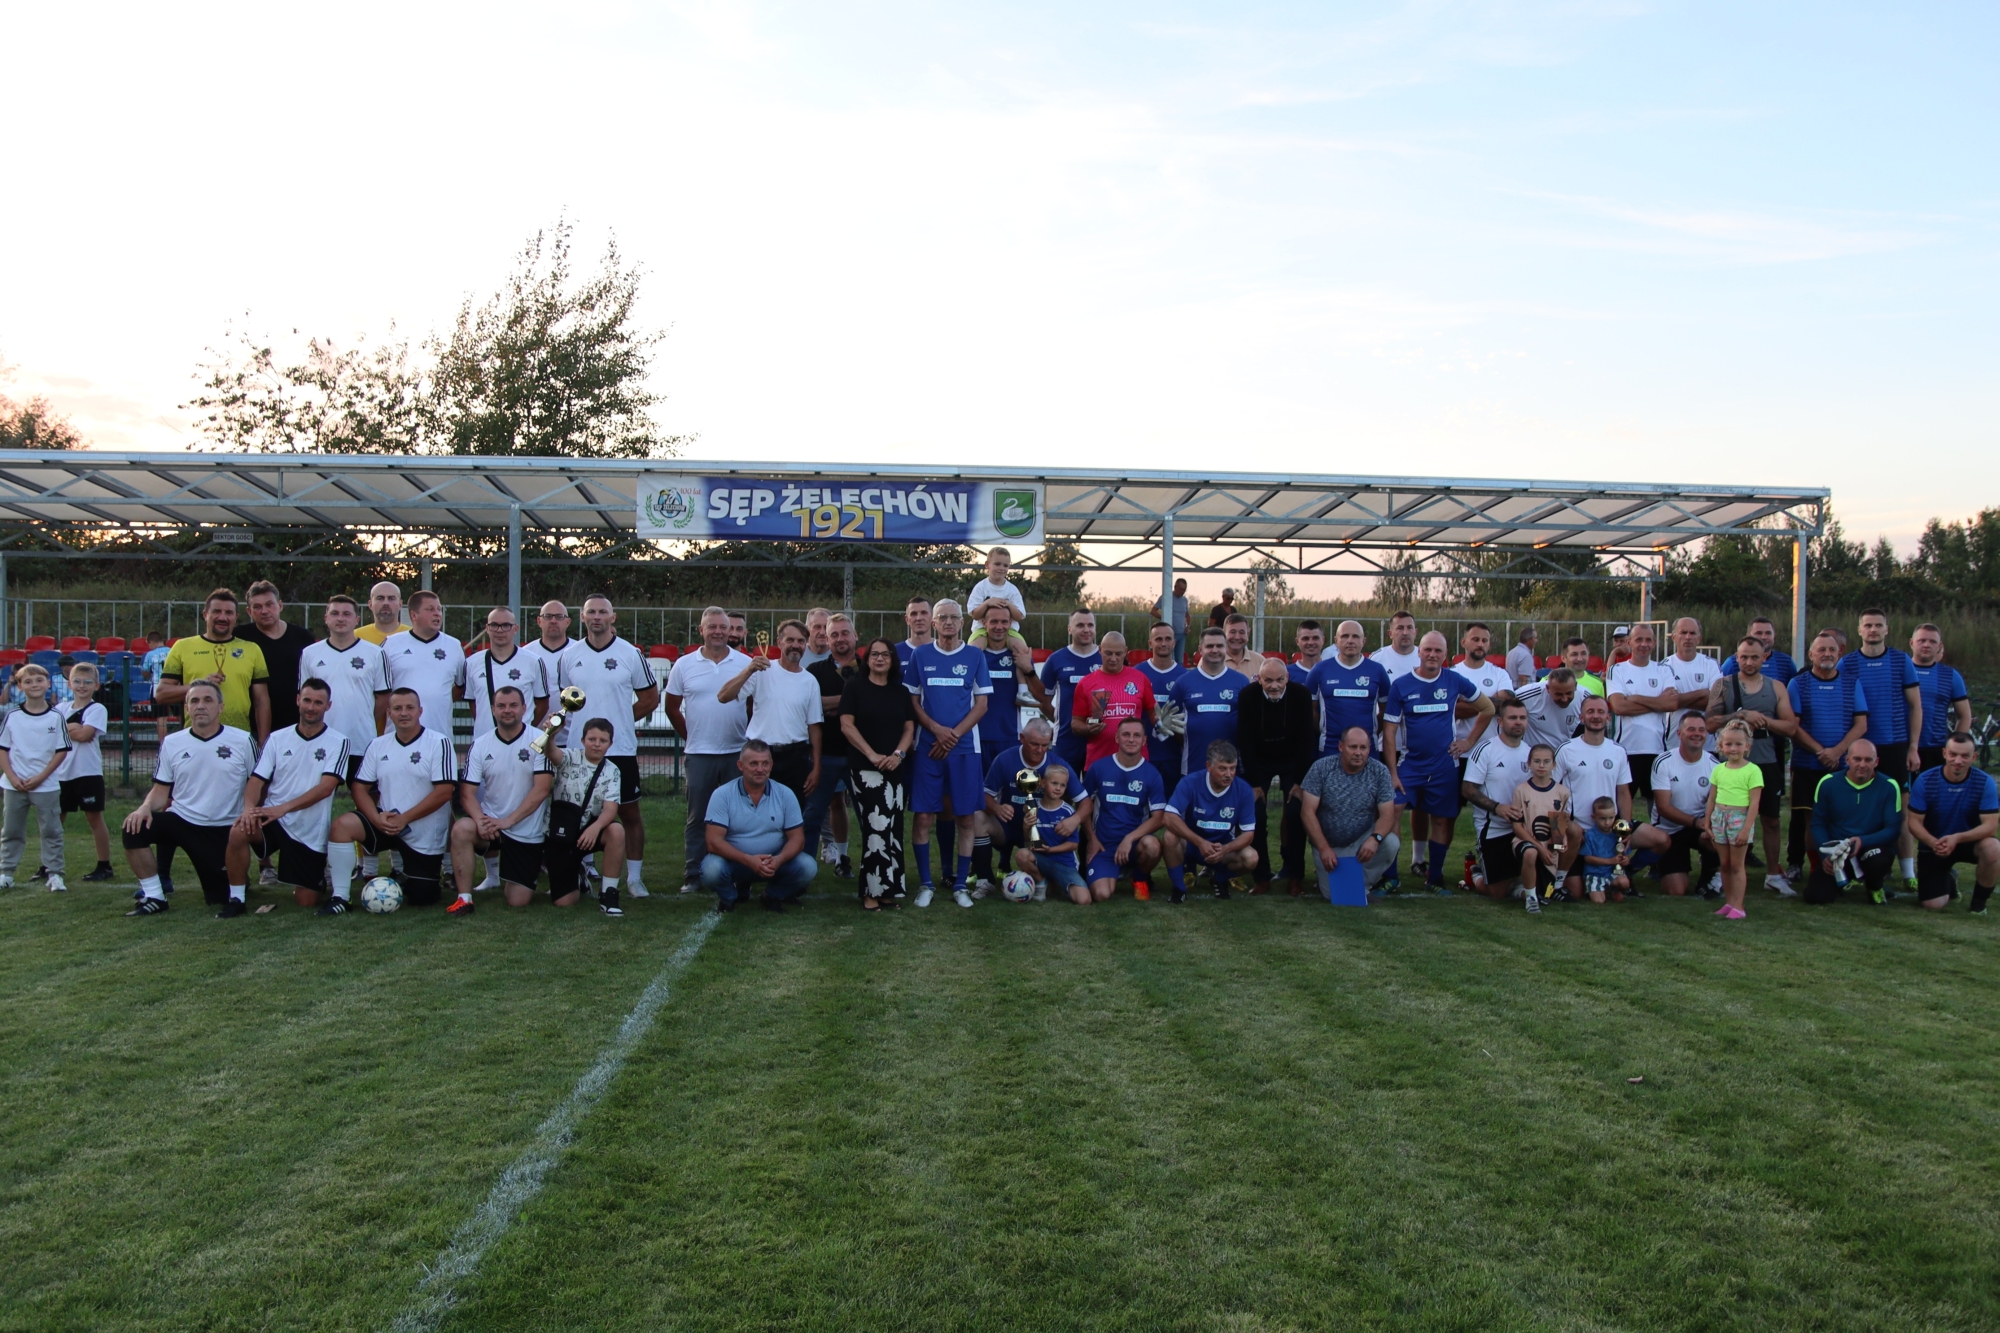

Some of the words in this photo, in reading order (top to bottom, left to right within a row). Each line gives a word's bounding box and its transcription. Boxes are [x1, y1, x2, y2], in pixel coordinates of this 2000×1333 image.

[708, 488, 775, 525] SĘP
[780, 484, 969, 524] ŻELECHÓW
[792, 504, 884, 539] 1921
